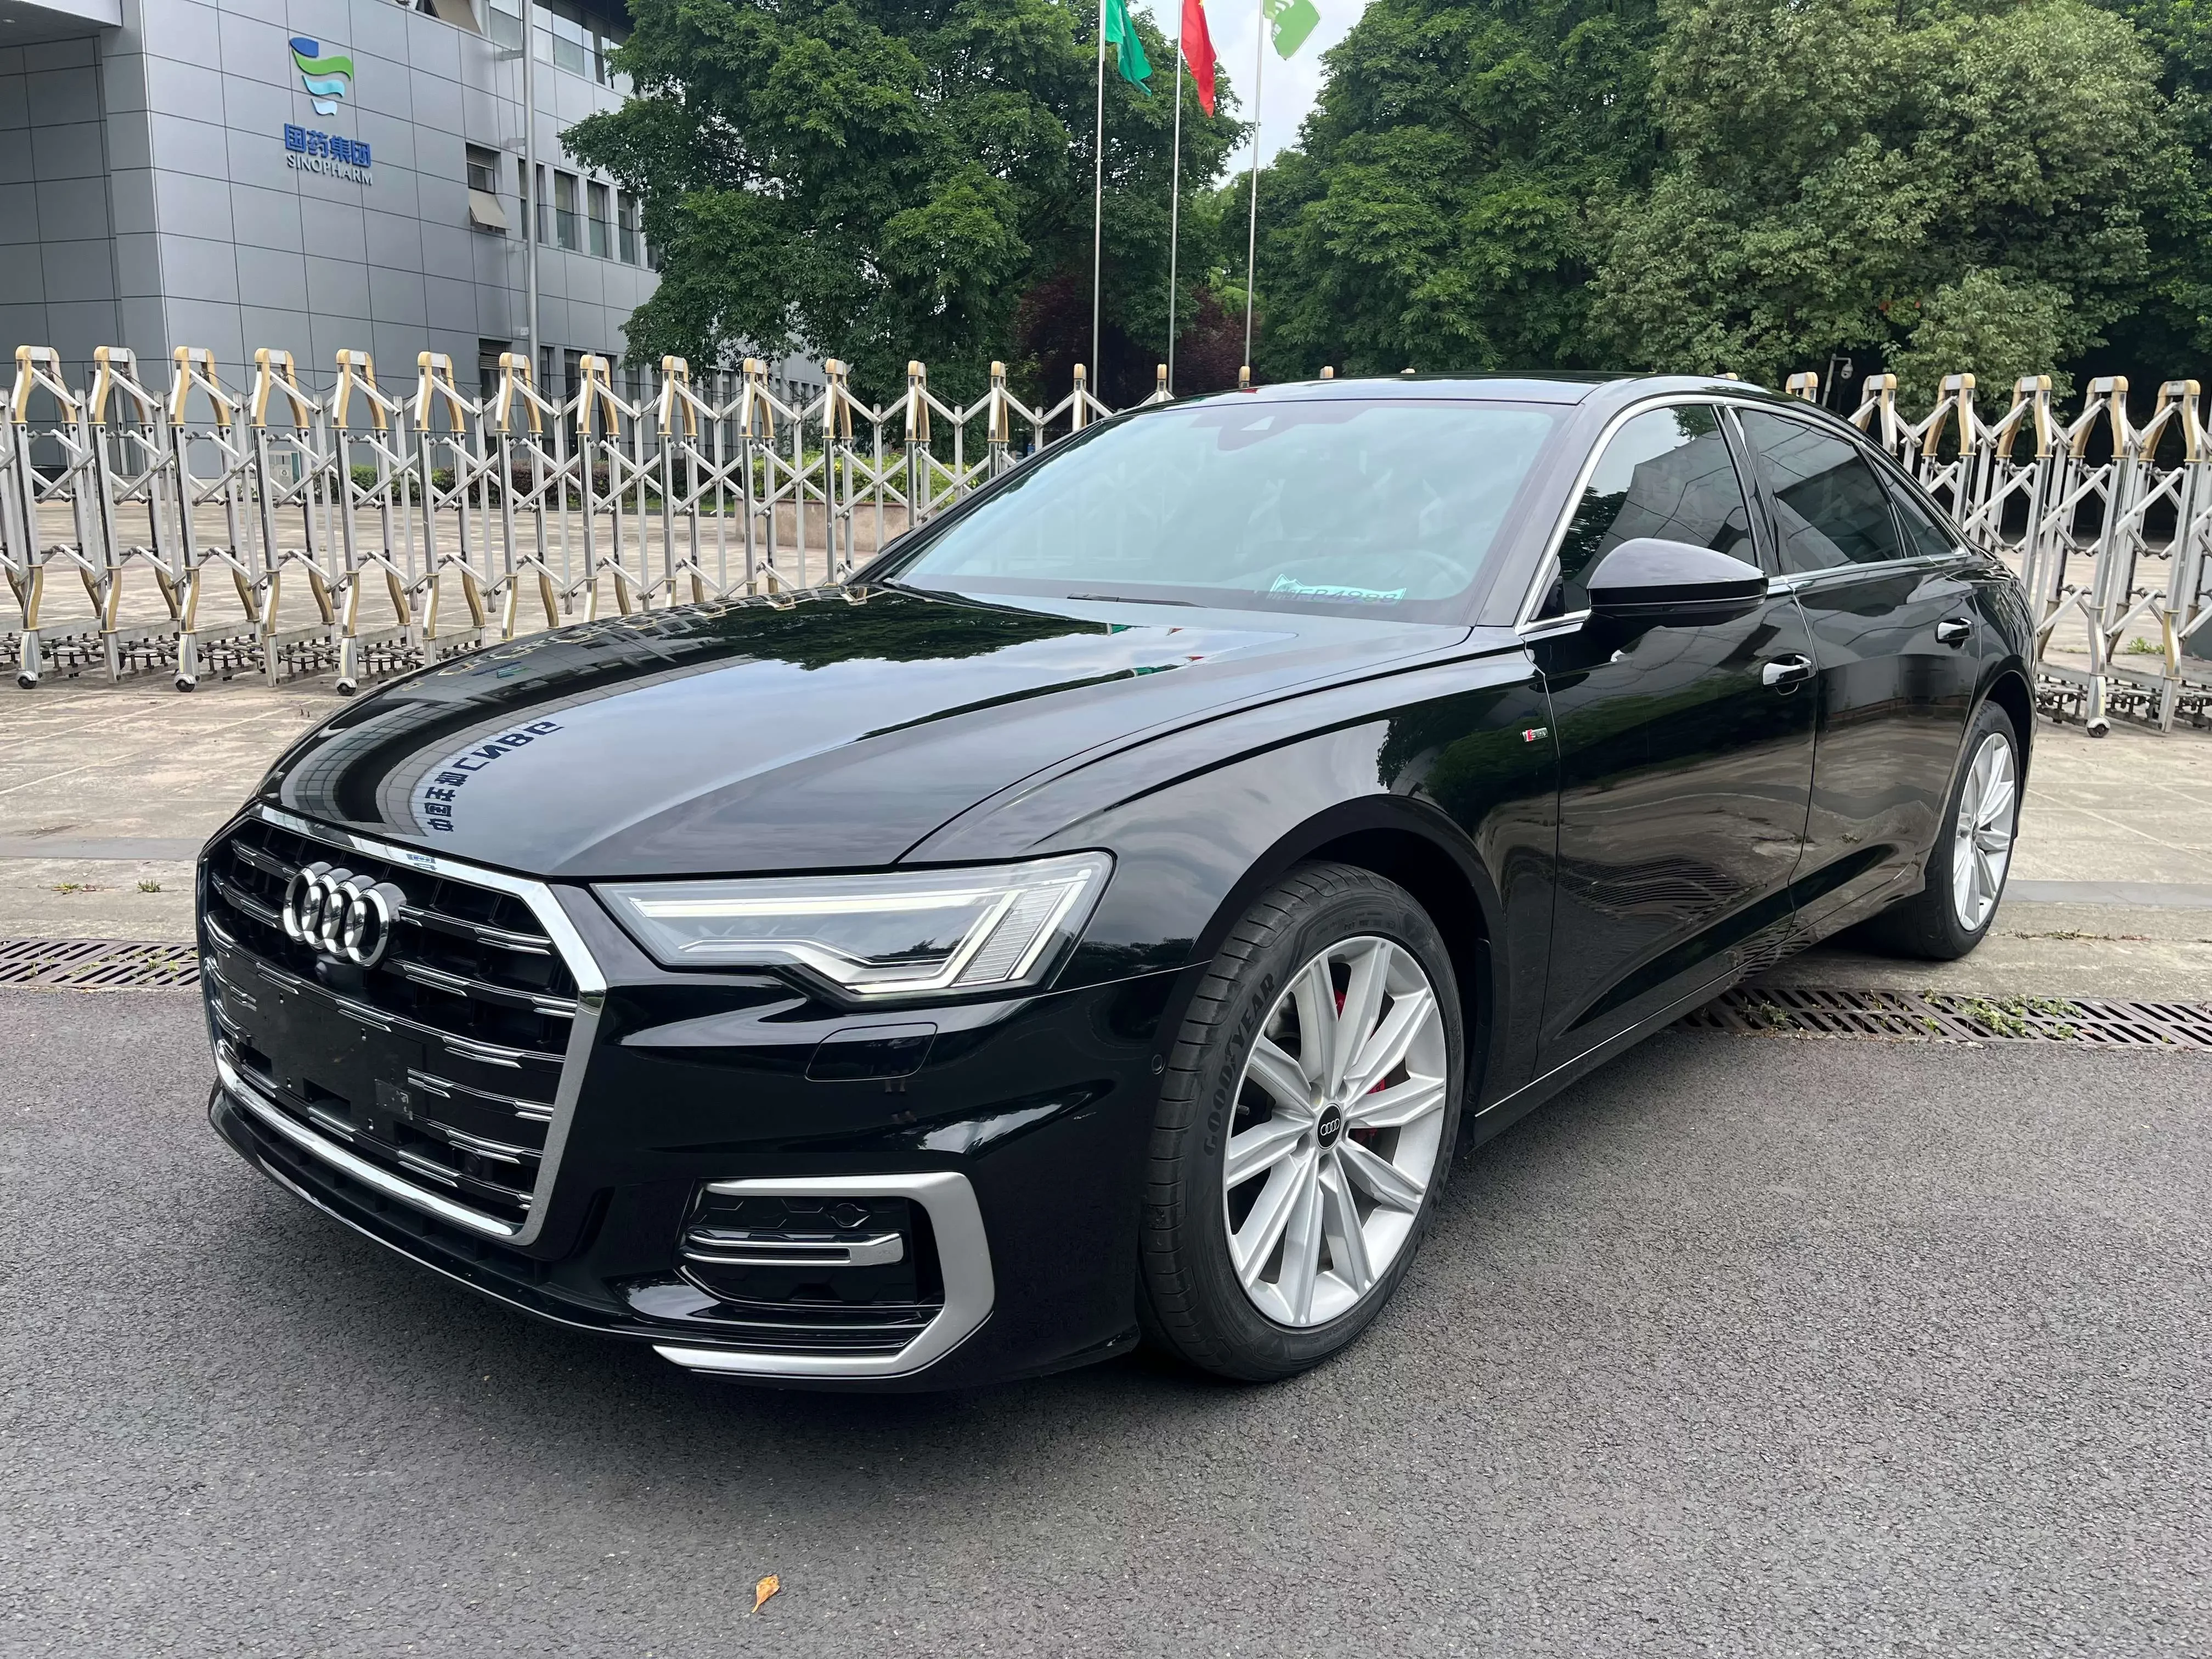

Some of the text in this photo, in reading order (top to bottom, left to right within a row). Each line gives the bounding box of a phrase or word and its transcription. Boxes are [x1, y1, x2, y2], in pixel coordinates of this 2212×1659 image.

[284, 123, 371, 168] 国药集团
[286, 155, 373, 185] SINOPHARM
